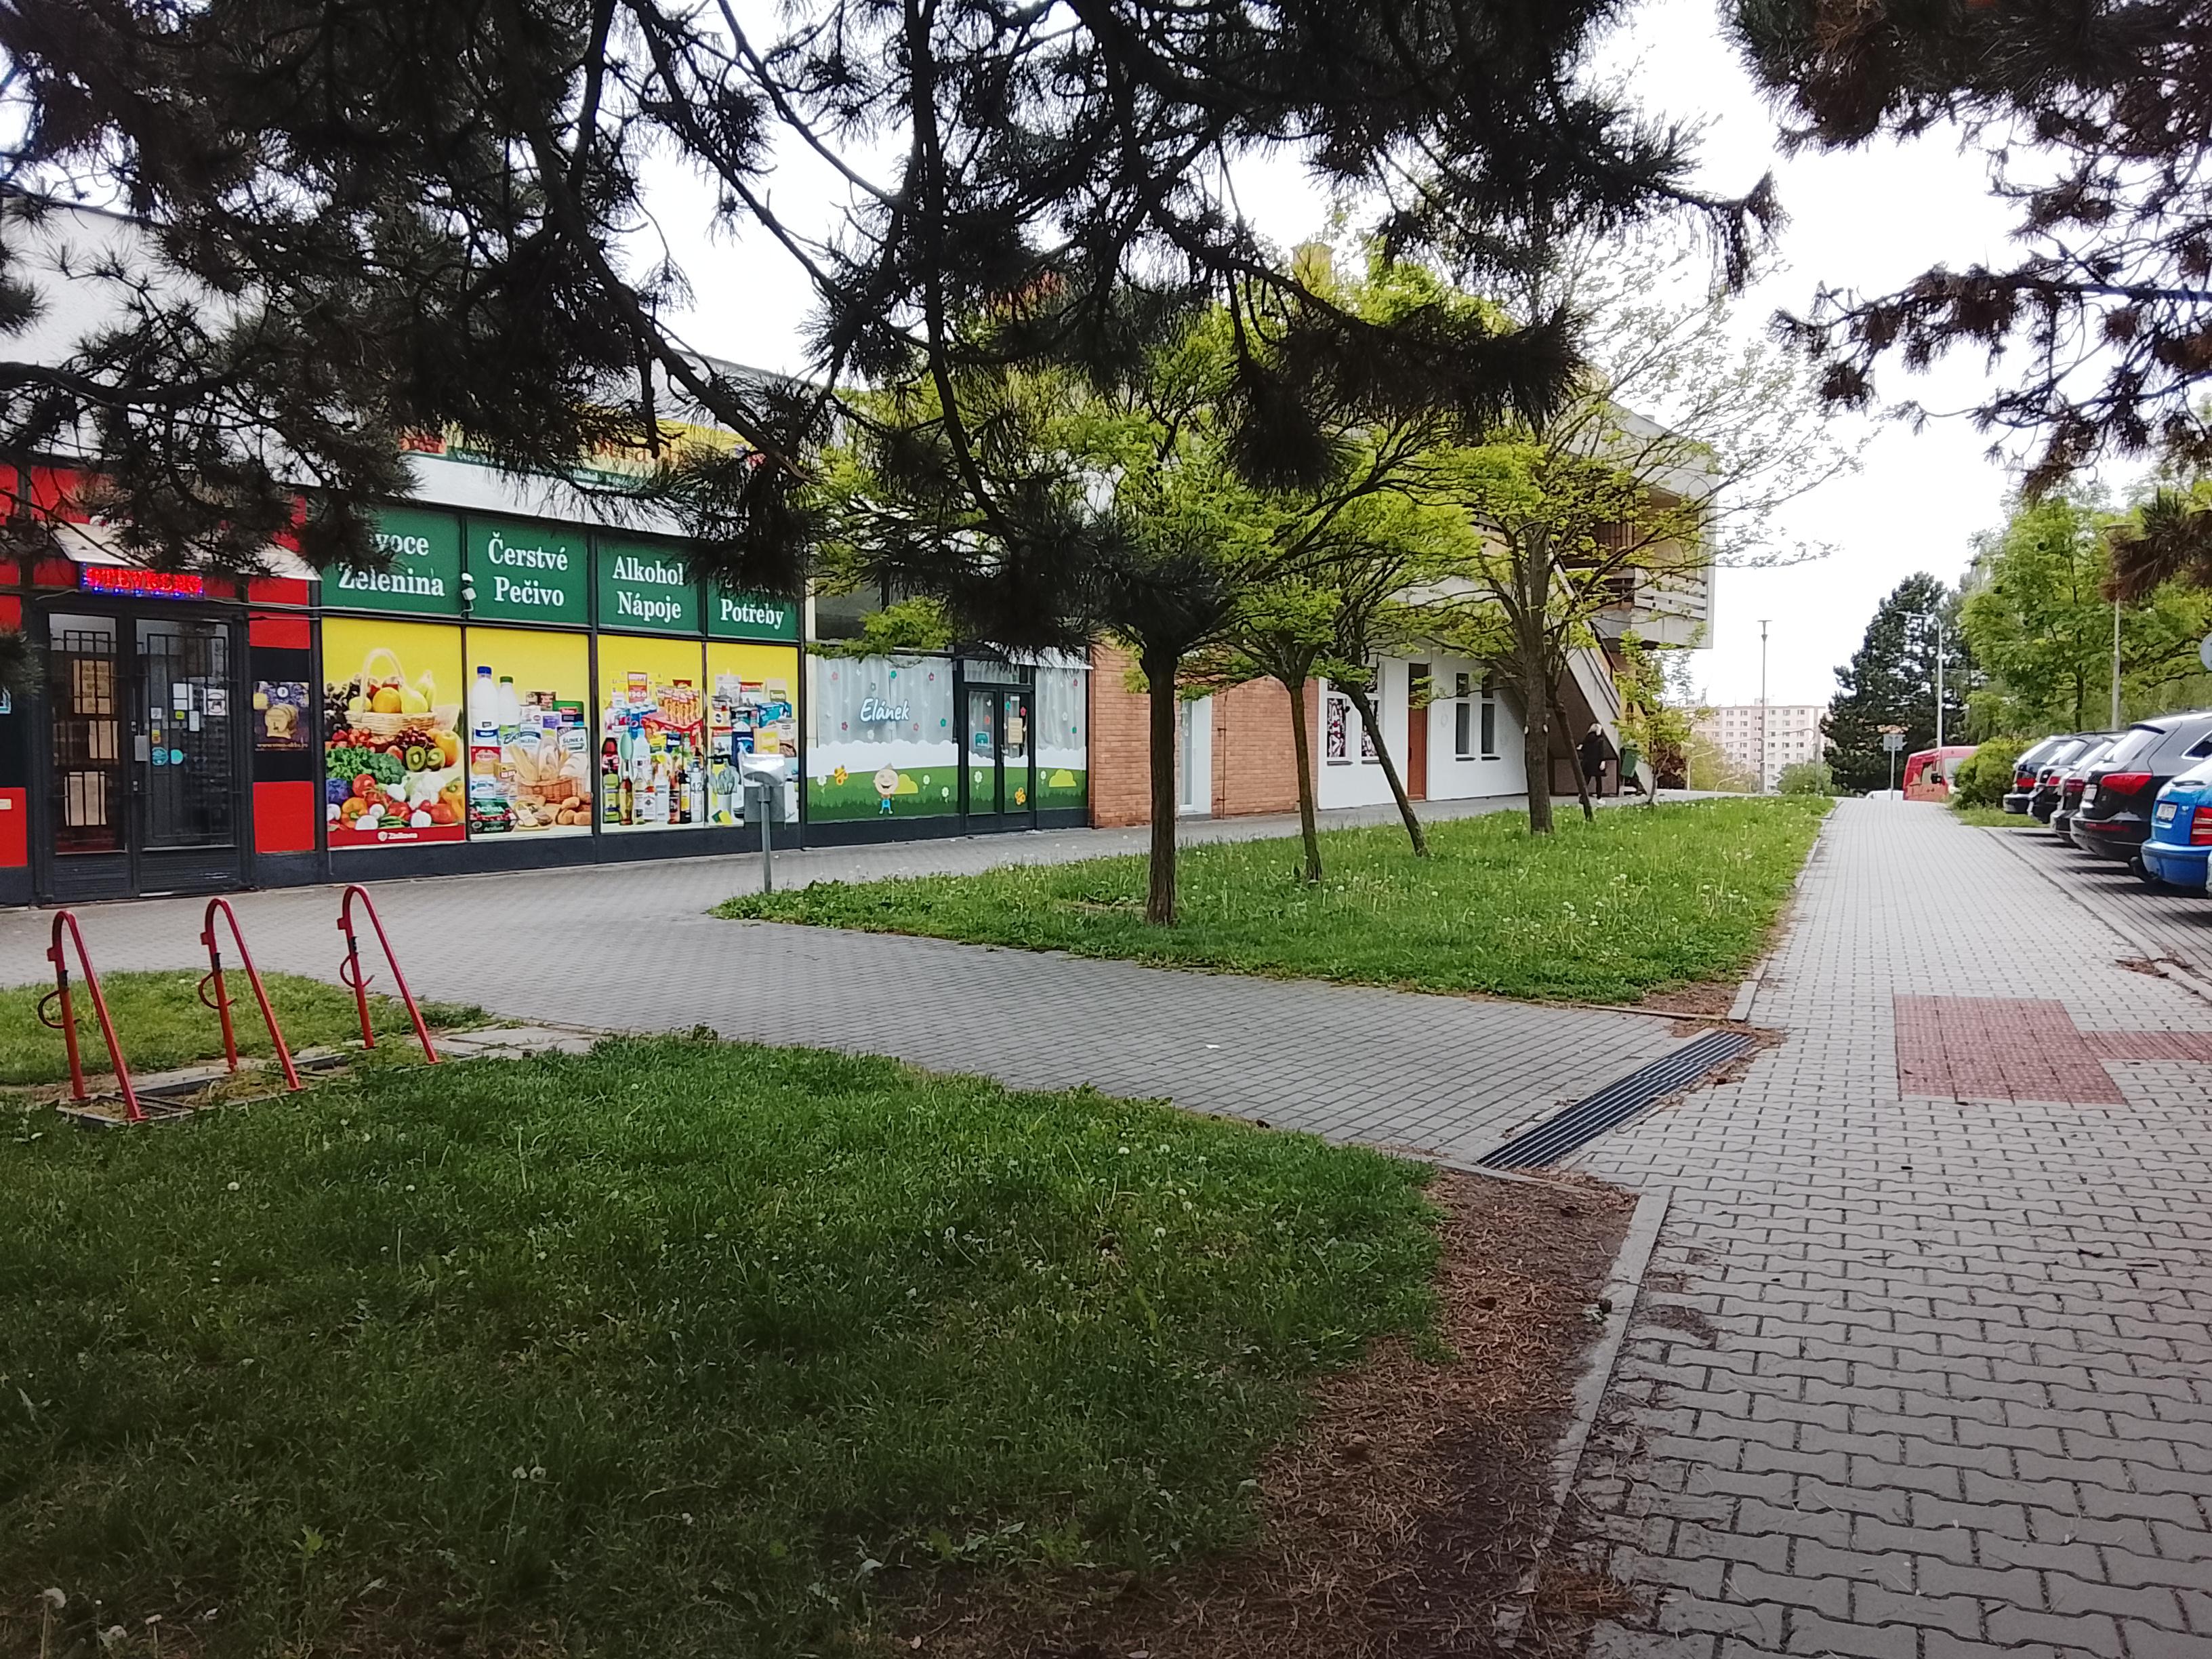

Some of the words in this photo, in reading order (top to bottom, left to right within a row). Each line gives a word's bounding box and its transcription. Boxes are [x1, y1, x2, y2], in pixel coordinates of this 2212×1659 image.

[369, 533, 430, 556] voce
[488, 531, 569, 571] Čerstvé
[338, 561, 446, 597] Zelenina
[612, 556, 684, 586] Alkohol
[493, 576, 565, 607] Pečivo
[617, 591, 682, 623] Nápoje
[720, 598, 784, 630] Potřeby
[860, 698, 909, 722] Elánek
